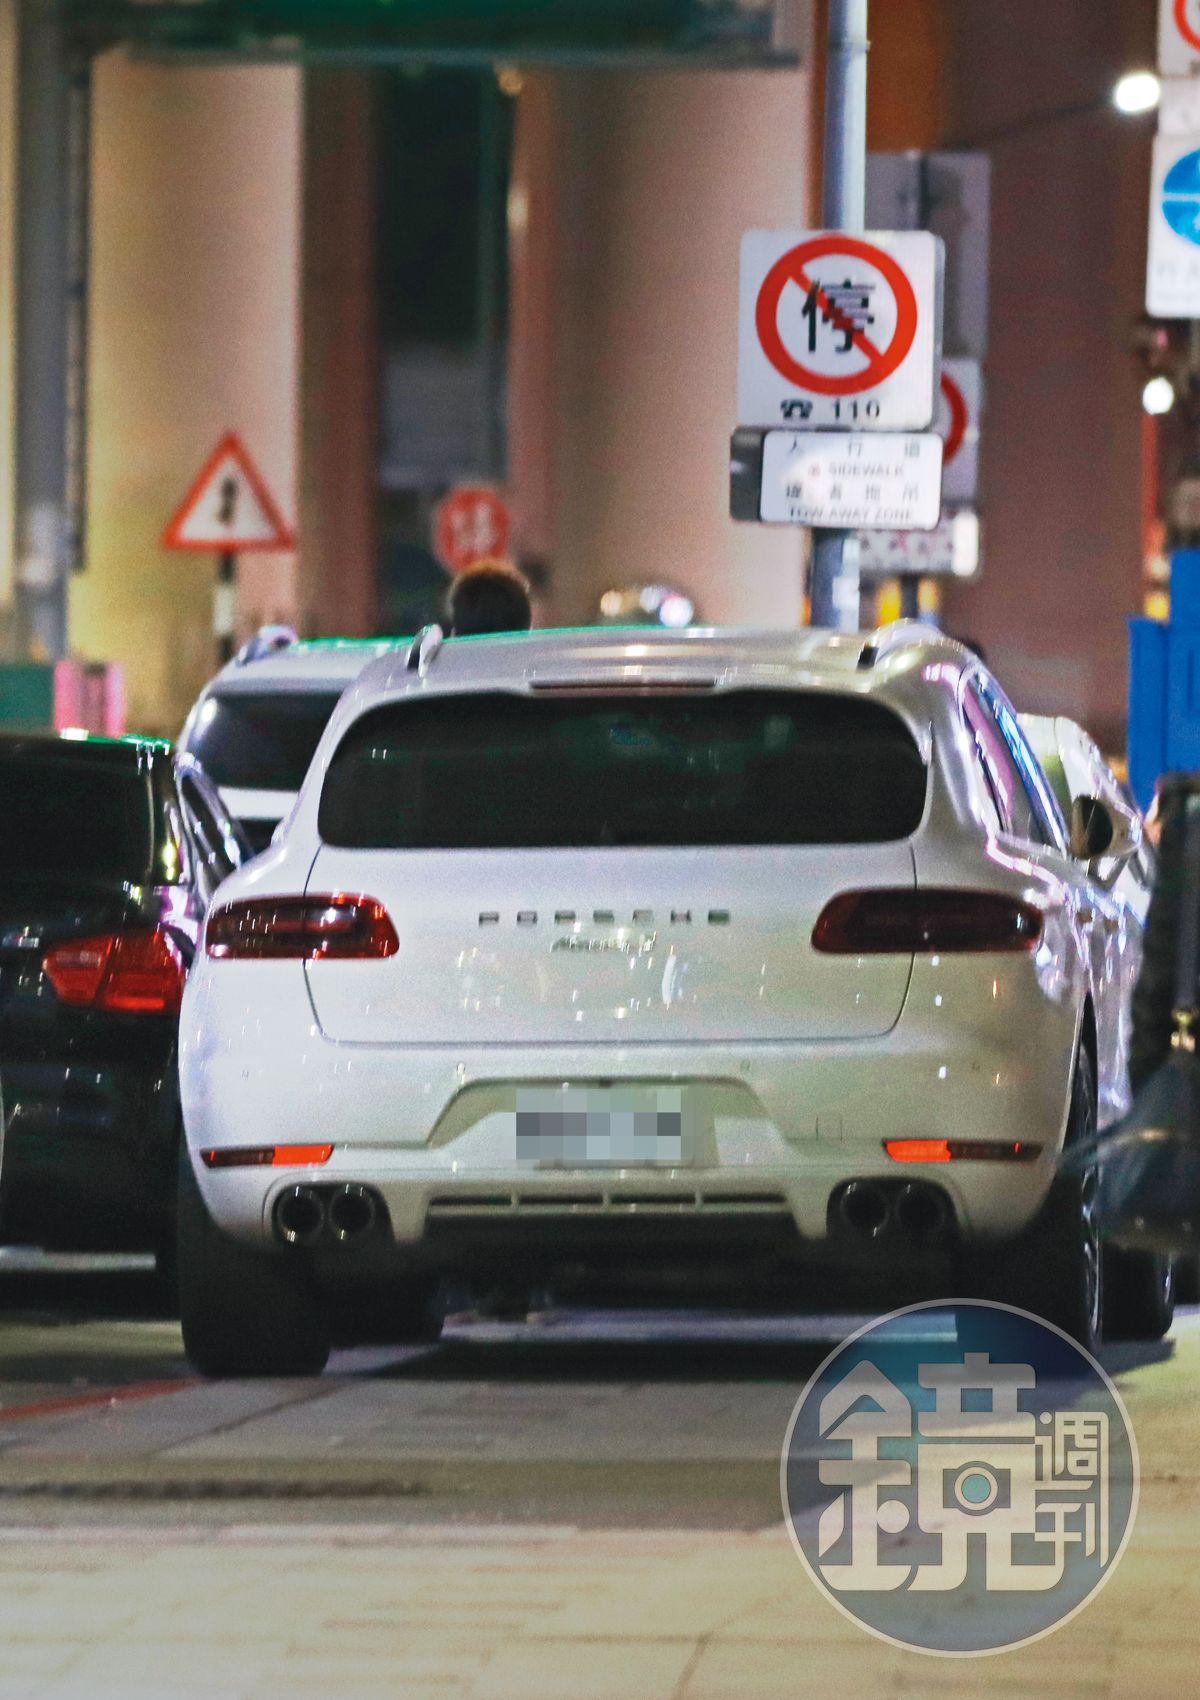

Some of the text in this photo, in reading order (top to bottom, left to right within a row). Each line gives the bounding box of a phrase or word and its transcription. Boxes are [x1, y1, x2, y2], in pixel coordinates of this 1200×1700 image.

[801, 278, 876, 354] 停
[831, 399, 881, 420] 110
[828, 461, 905, 477] SIDEWALK
[789, 506, 914, 521] TOW AWAY ZONE
[478, 909, 731, 927] PORSCHE
